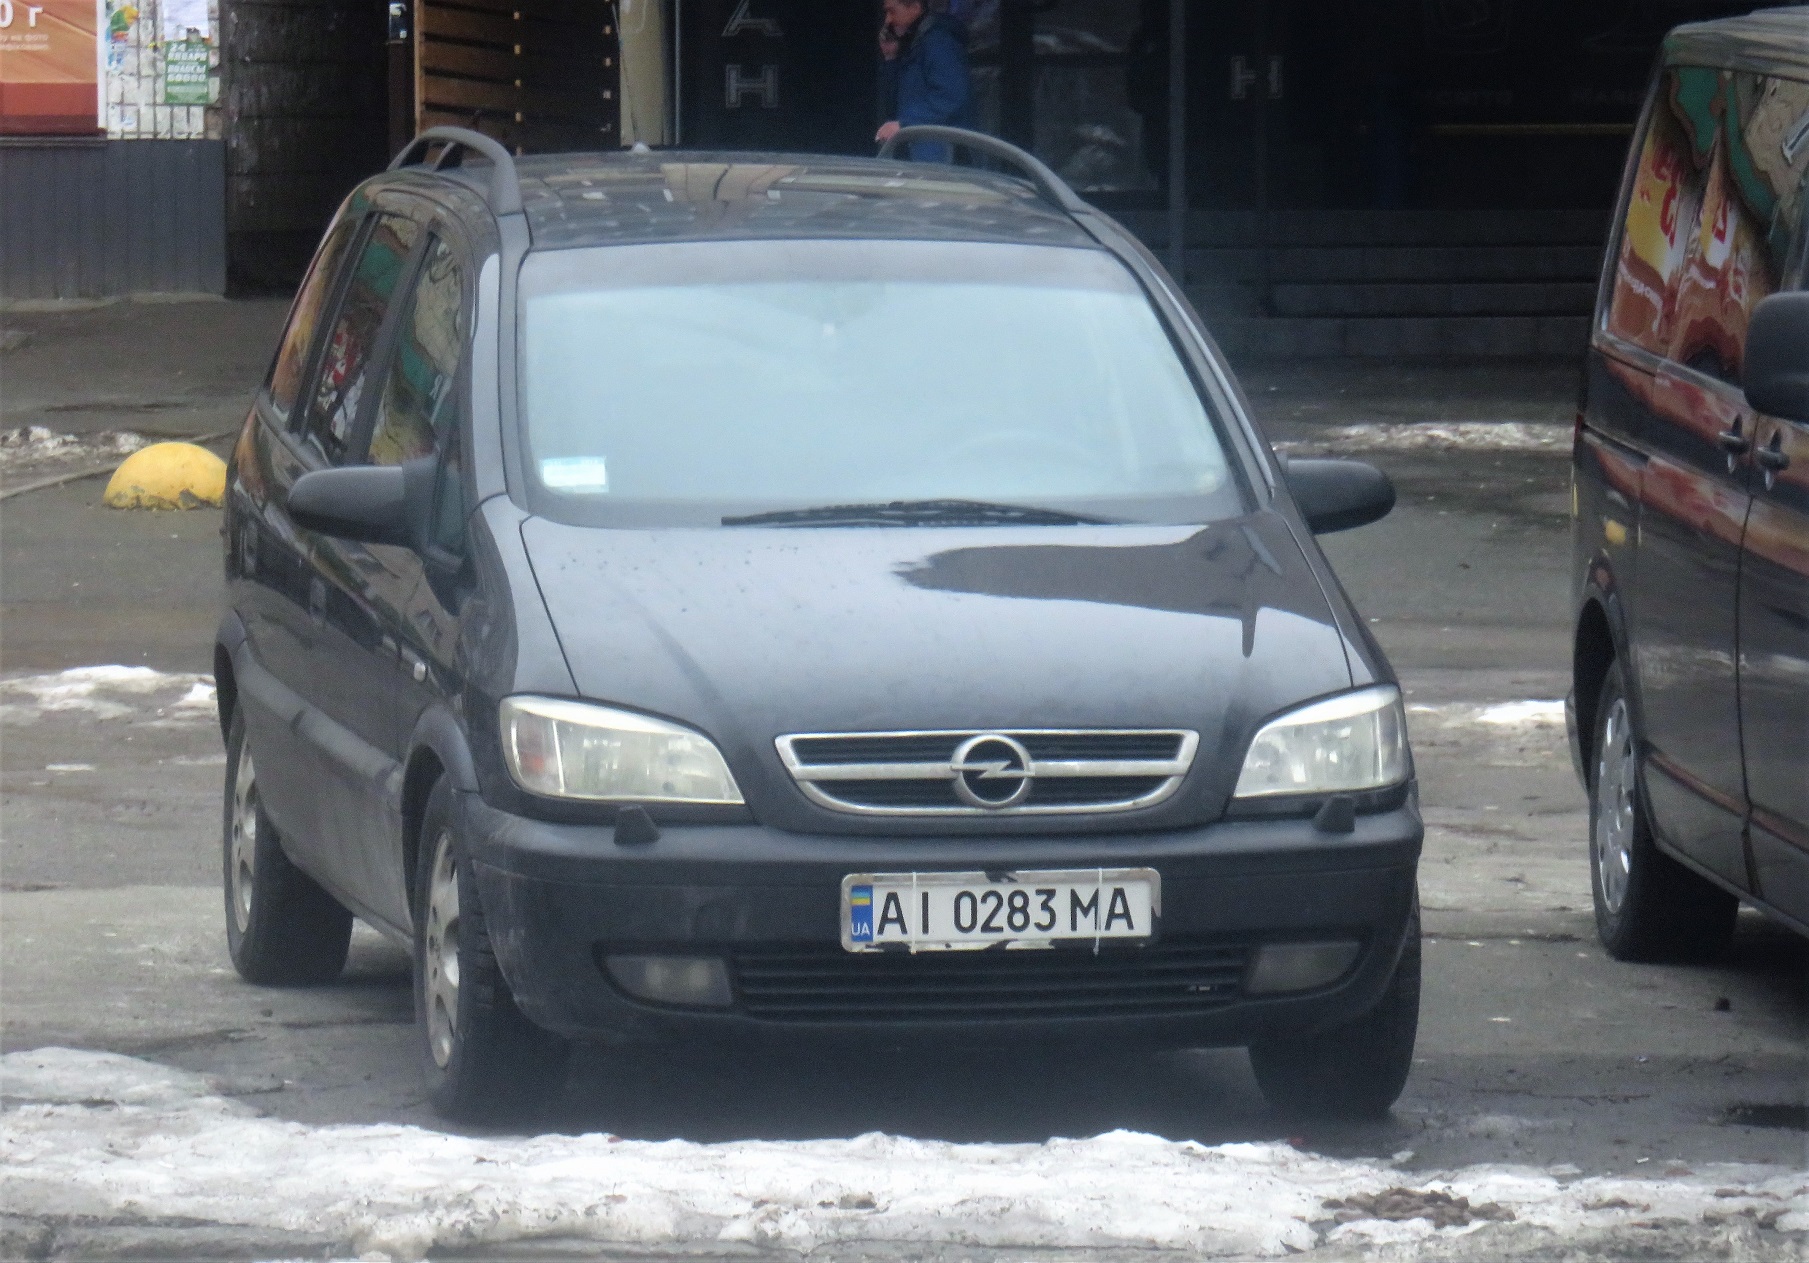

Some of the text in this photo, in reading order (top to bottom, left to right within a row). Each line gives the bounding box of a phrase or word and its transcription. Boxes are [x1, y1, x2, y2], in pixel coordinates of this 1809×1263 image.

[953, 888, 1057, 934] 0283
[1070, 887, 1134, 932] MA
[851, 922, 870, 936] UA
